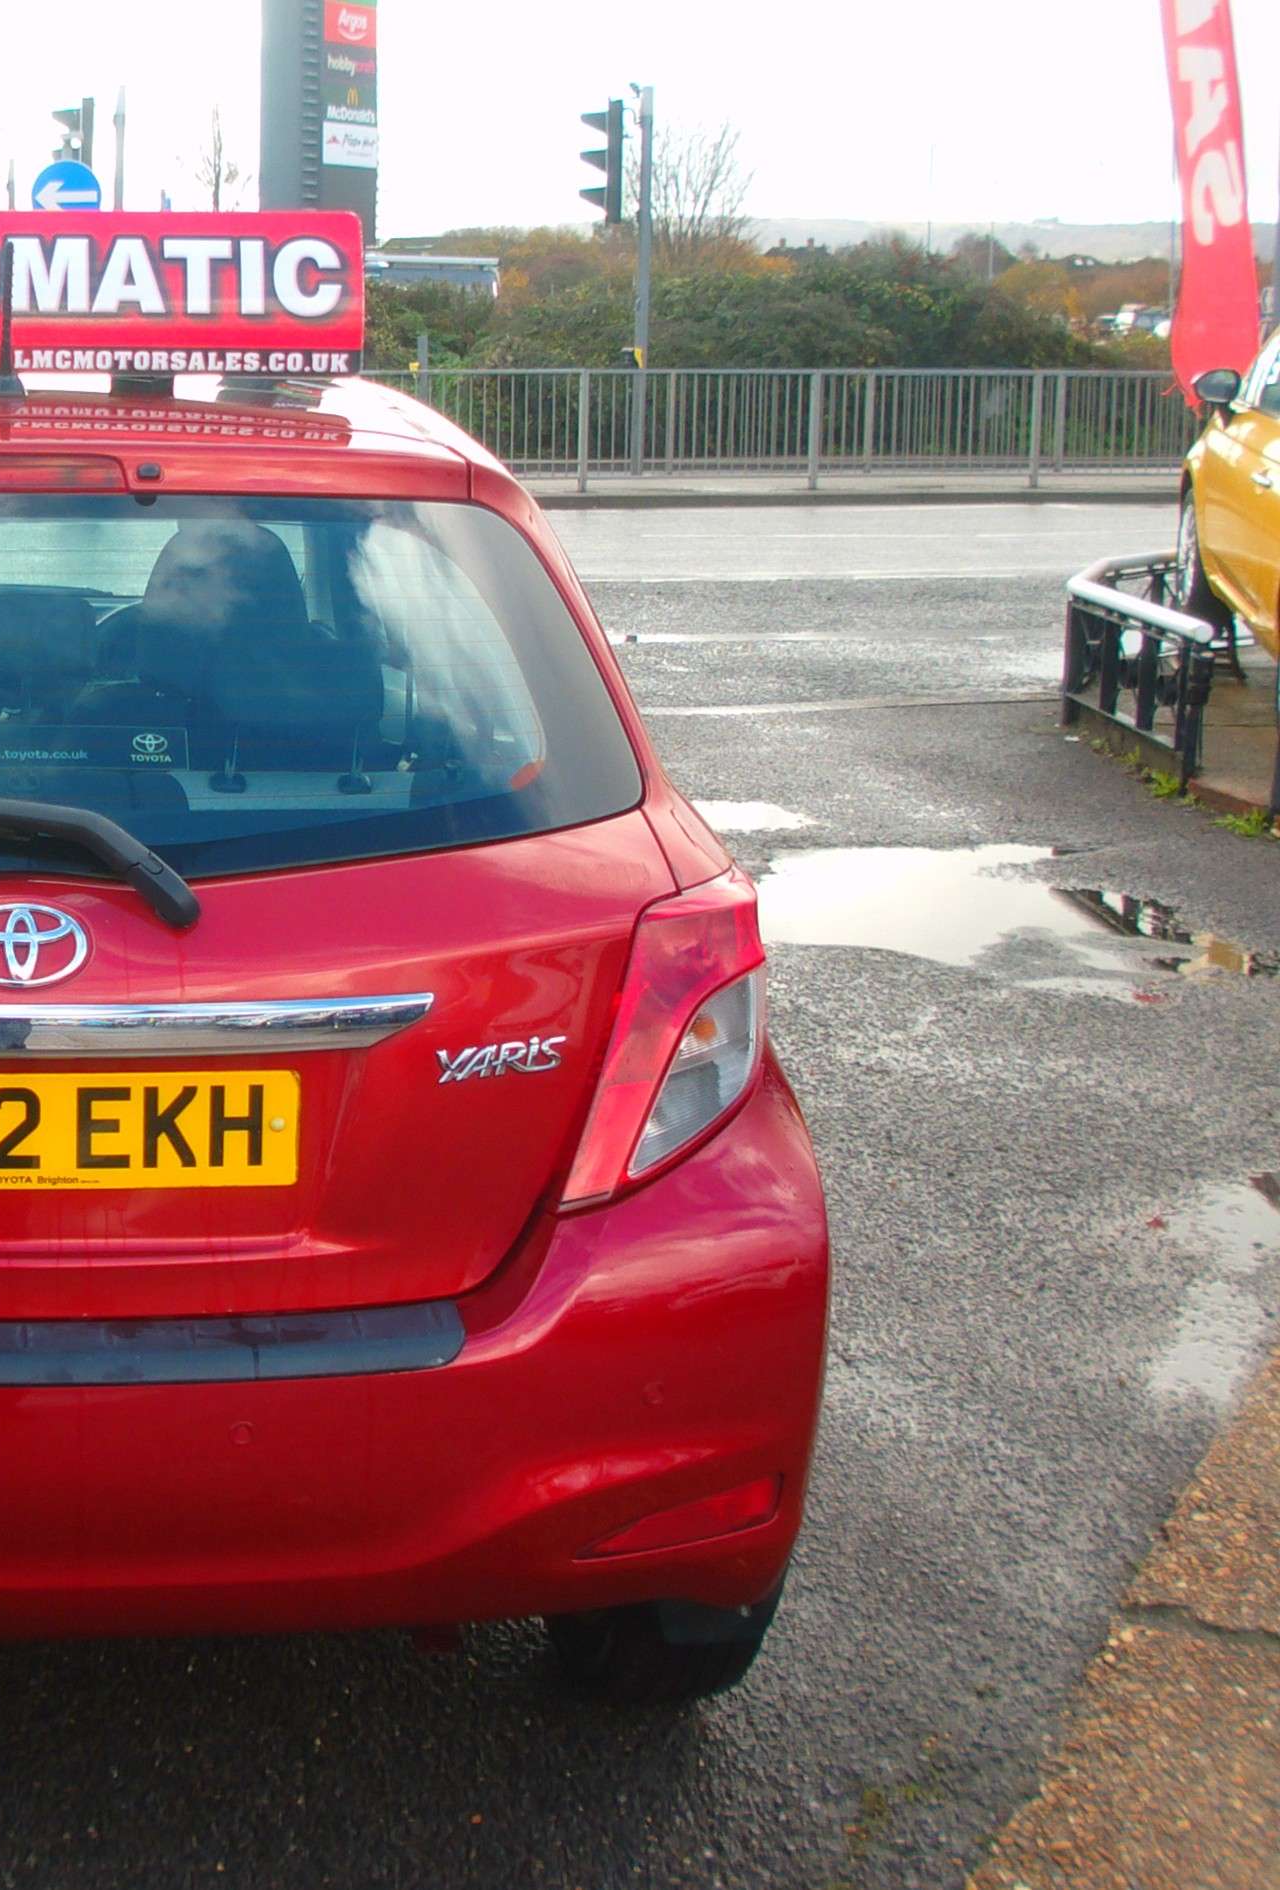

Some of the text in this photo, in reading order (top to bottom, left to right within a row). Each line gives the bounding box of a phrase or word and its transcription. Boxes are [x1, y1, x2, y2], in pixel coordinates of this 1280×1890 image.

[339, 8, 368, 32] Argos
[14, 350, 349, 373] LMCMOTORSALES.CO.UK
[131, 754, 172, 763] TOYOTA
[76, 1084, 264, 1169] EKH
[37, 1175, 79, 1186] Brighton
